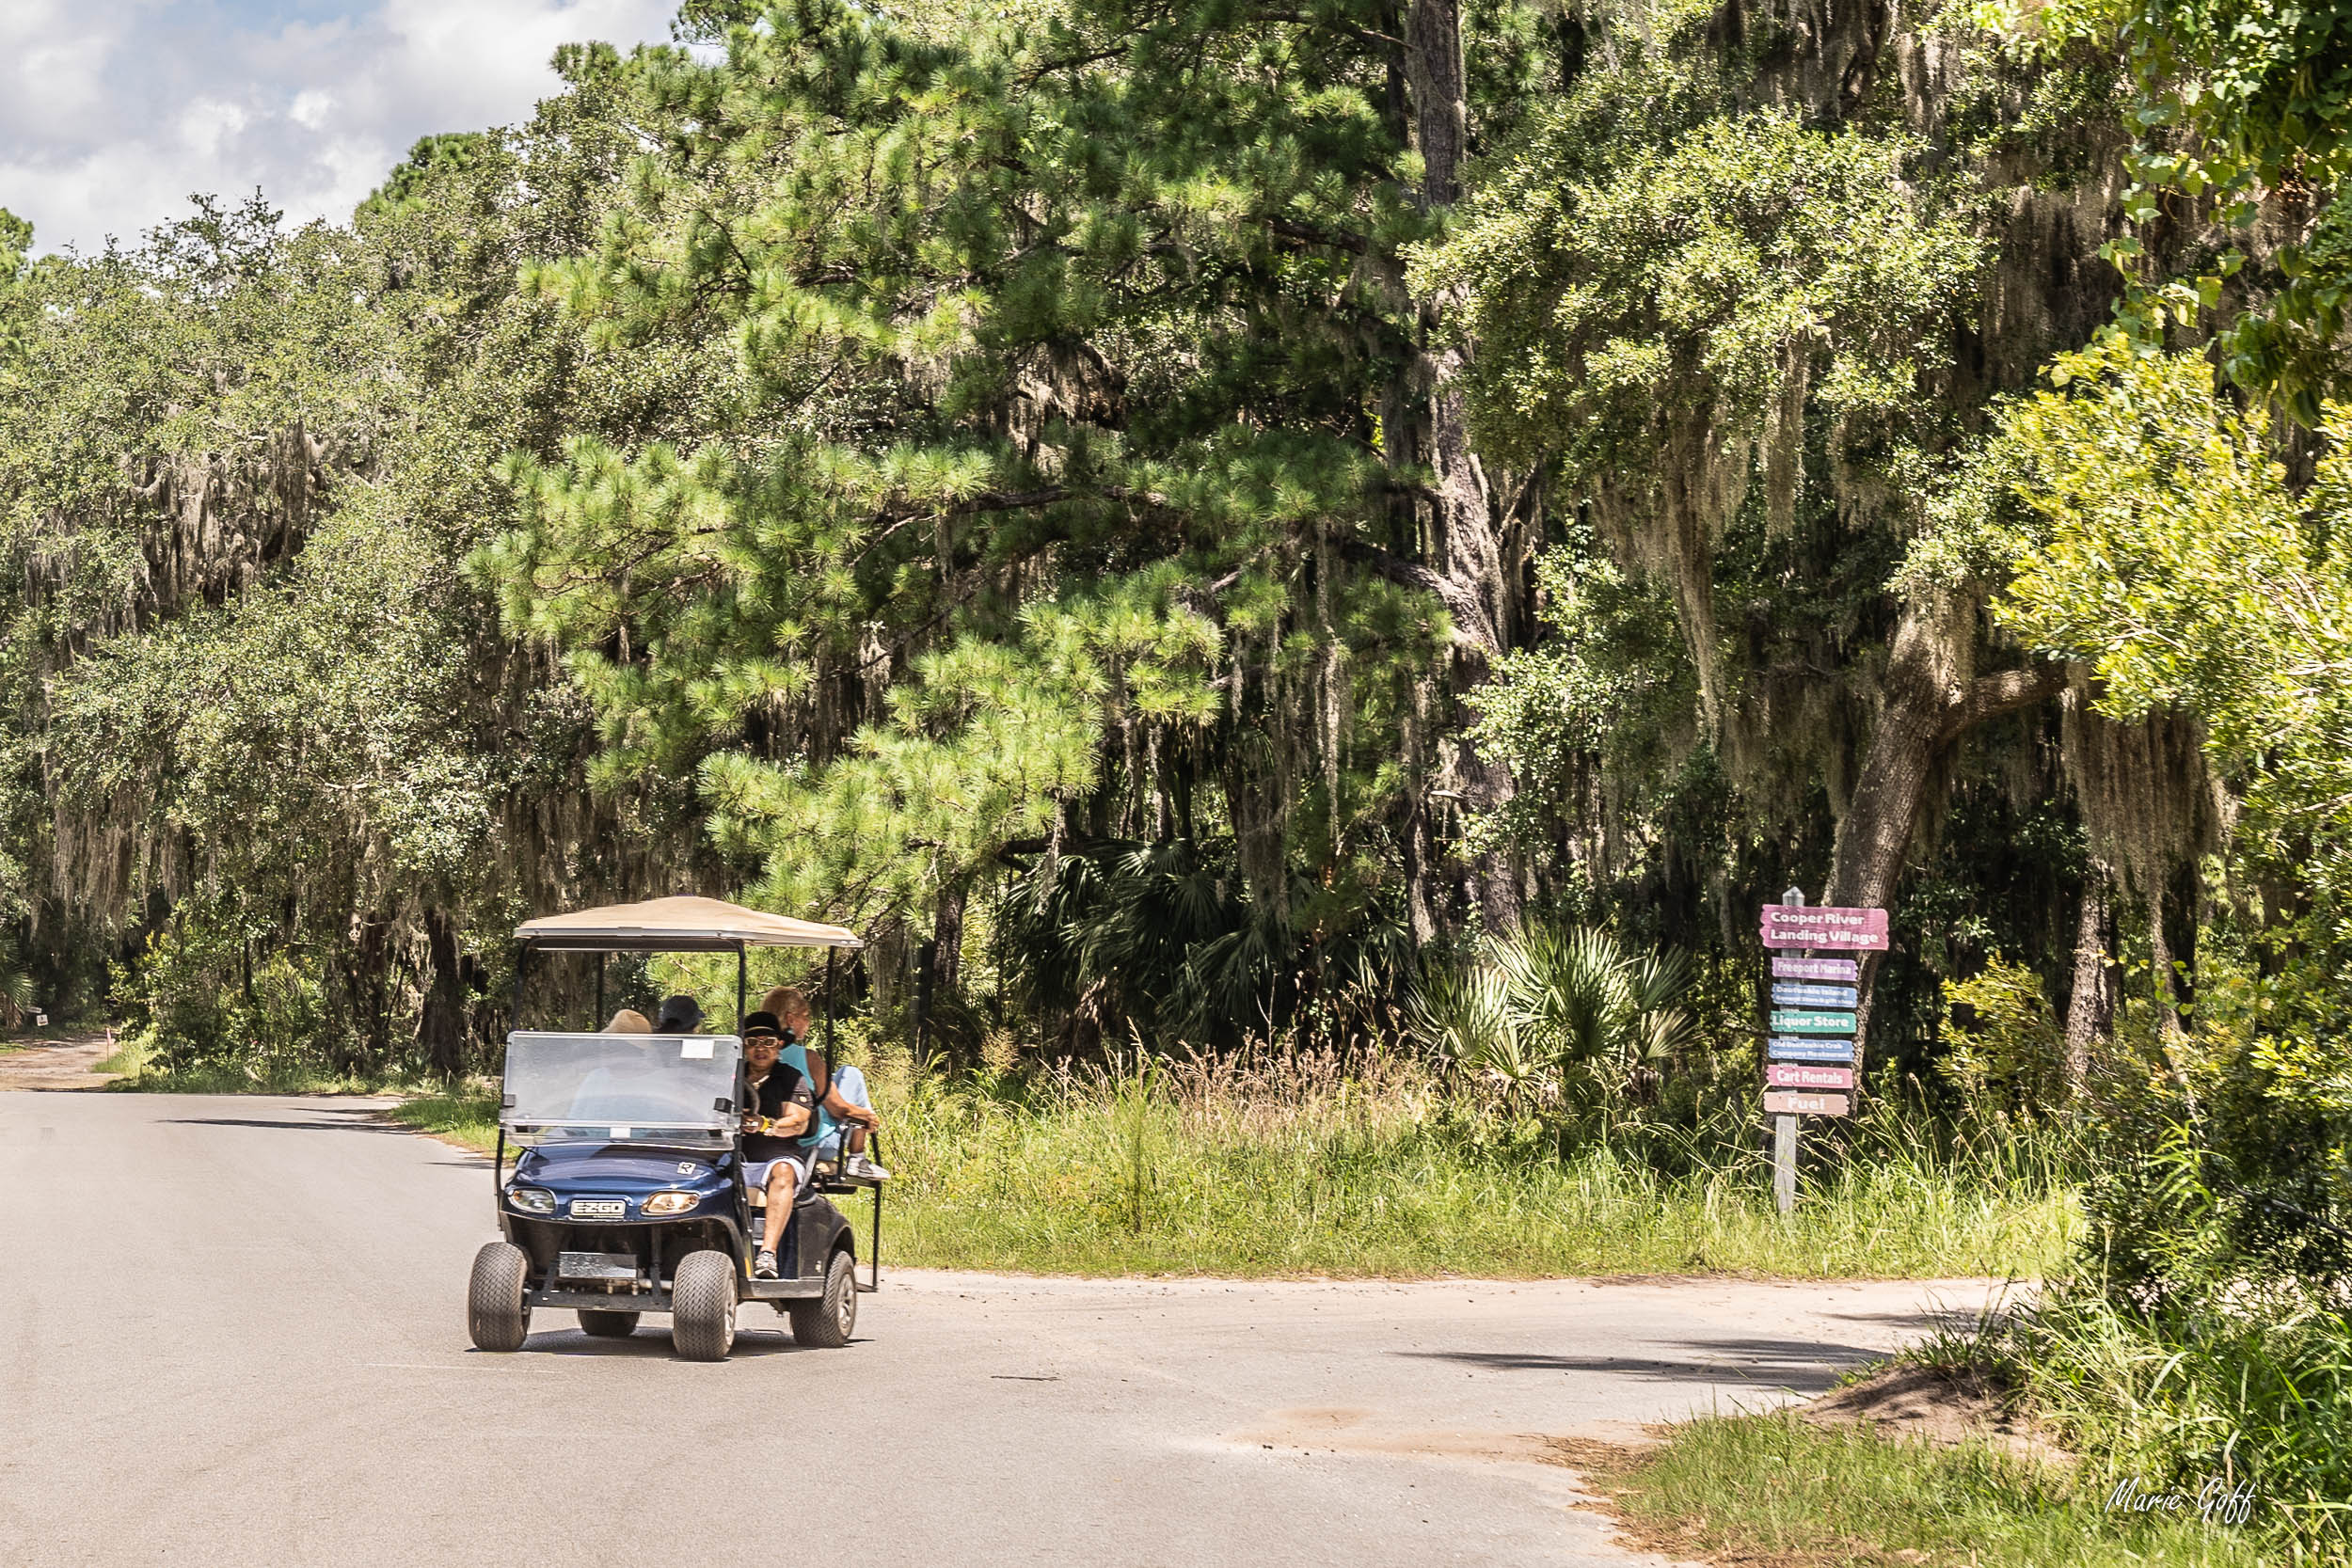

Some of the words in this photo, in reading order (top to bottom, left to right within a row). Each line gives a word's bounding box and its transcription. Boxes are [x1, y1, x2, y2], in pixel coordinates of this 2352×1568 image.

[1771, 911, 1823, 926] Cooper
[1825, 912, 1865, 925] River
[1771, 928, 1828, 943] Landing
[1829, 930, 1879, 945] Village
[1777, 961, 1819, 974] Freeport
[1820, 962, 1851, 974] Marina
[1776, 986, 1820, 995] Daufuskie
[1821, 988, 1848, 996] Island
[1772, 1015, 1813, 1028] Liquor
[1814, 1016, 1849, 1027] Store
[1776, 1069, 1800, 1083] Cart
[1802, 1071, 1843, 1084] Rentals
[1788, 1097, 1825, 1110] Fuel
